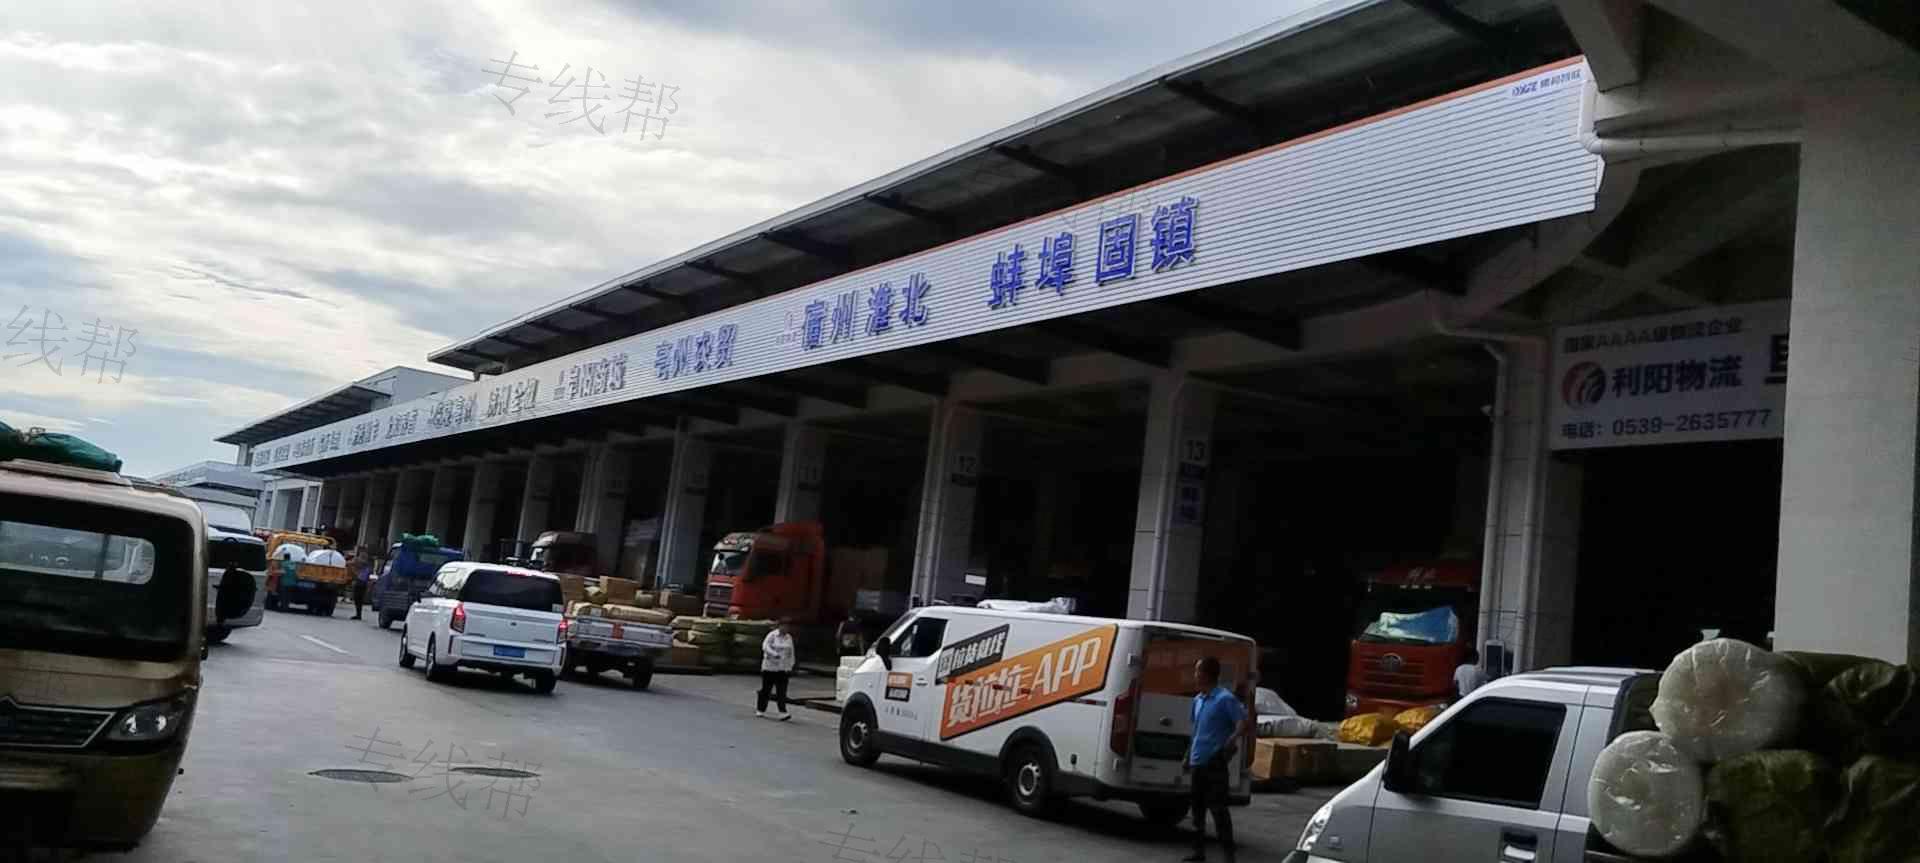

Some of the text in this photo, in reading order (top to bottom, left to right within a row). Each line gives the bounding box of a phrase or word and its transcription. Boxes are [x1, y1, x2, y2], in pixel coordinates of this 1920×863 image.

[987, 196, 1199, 309] 蚌埠固镇
[801, 271, 931, 352] 宿州淮北
[1612, 355, 1743, 397] 利阳物流
[1184, 440, 1207, 461] 13
